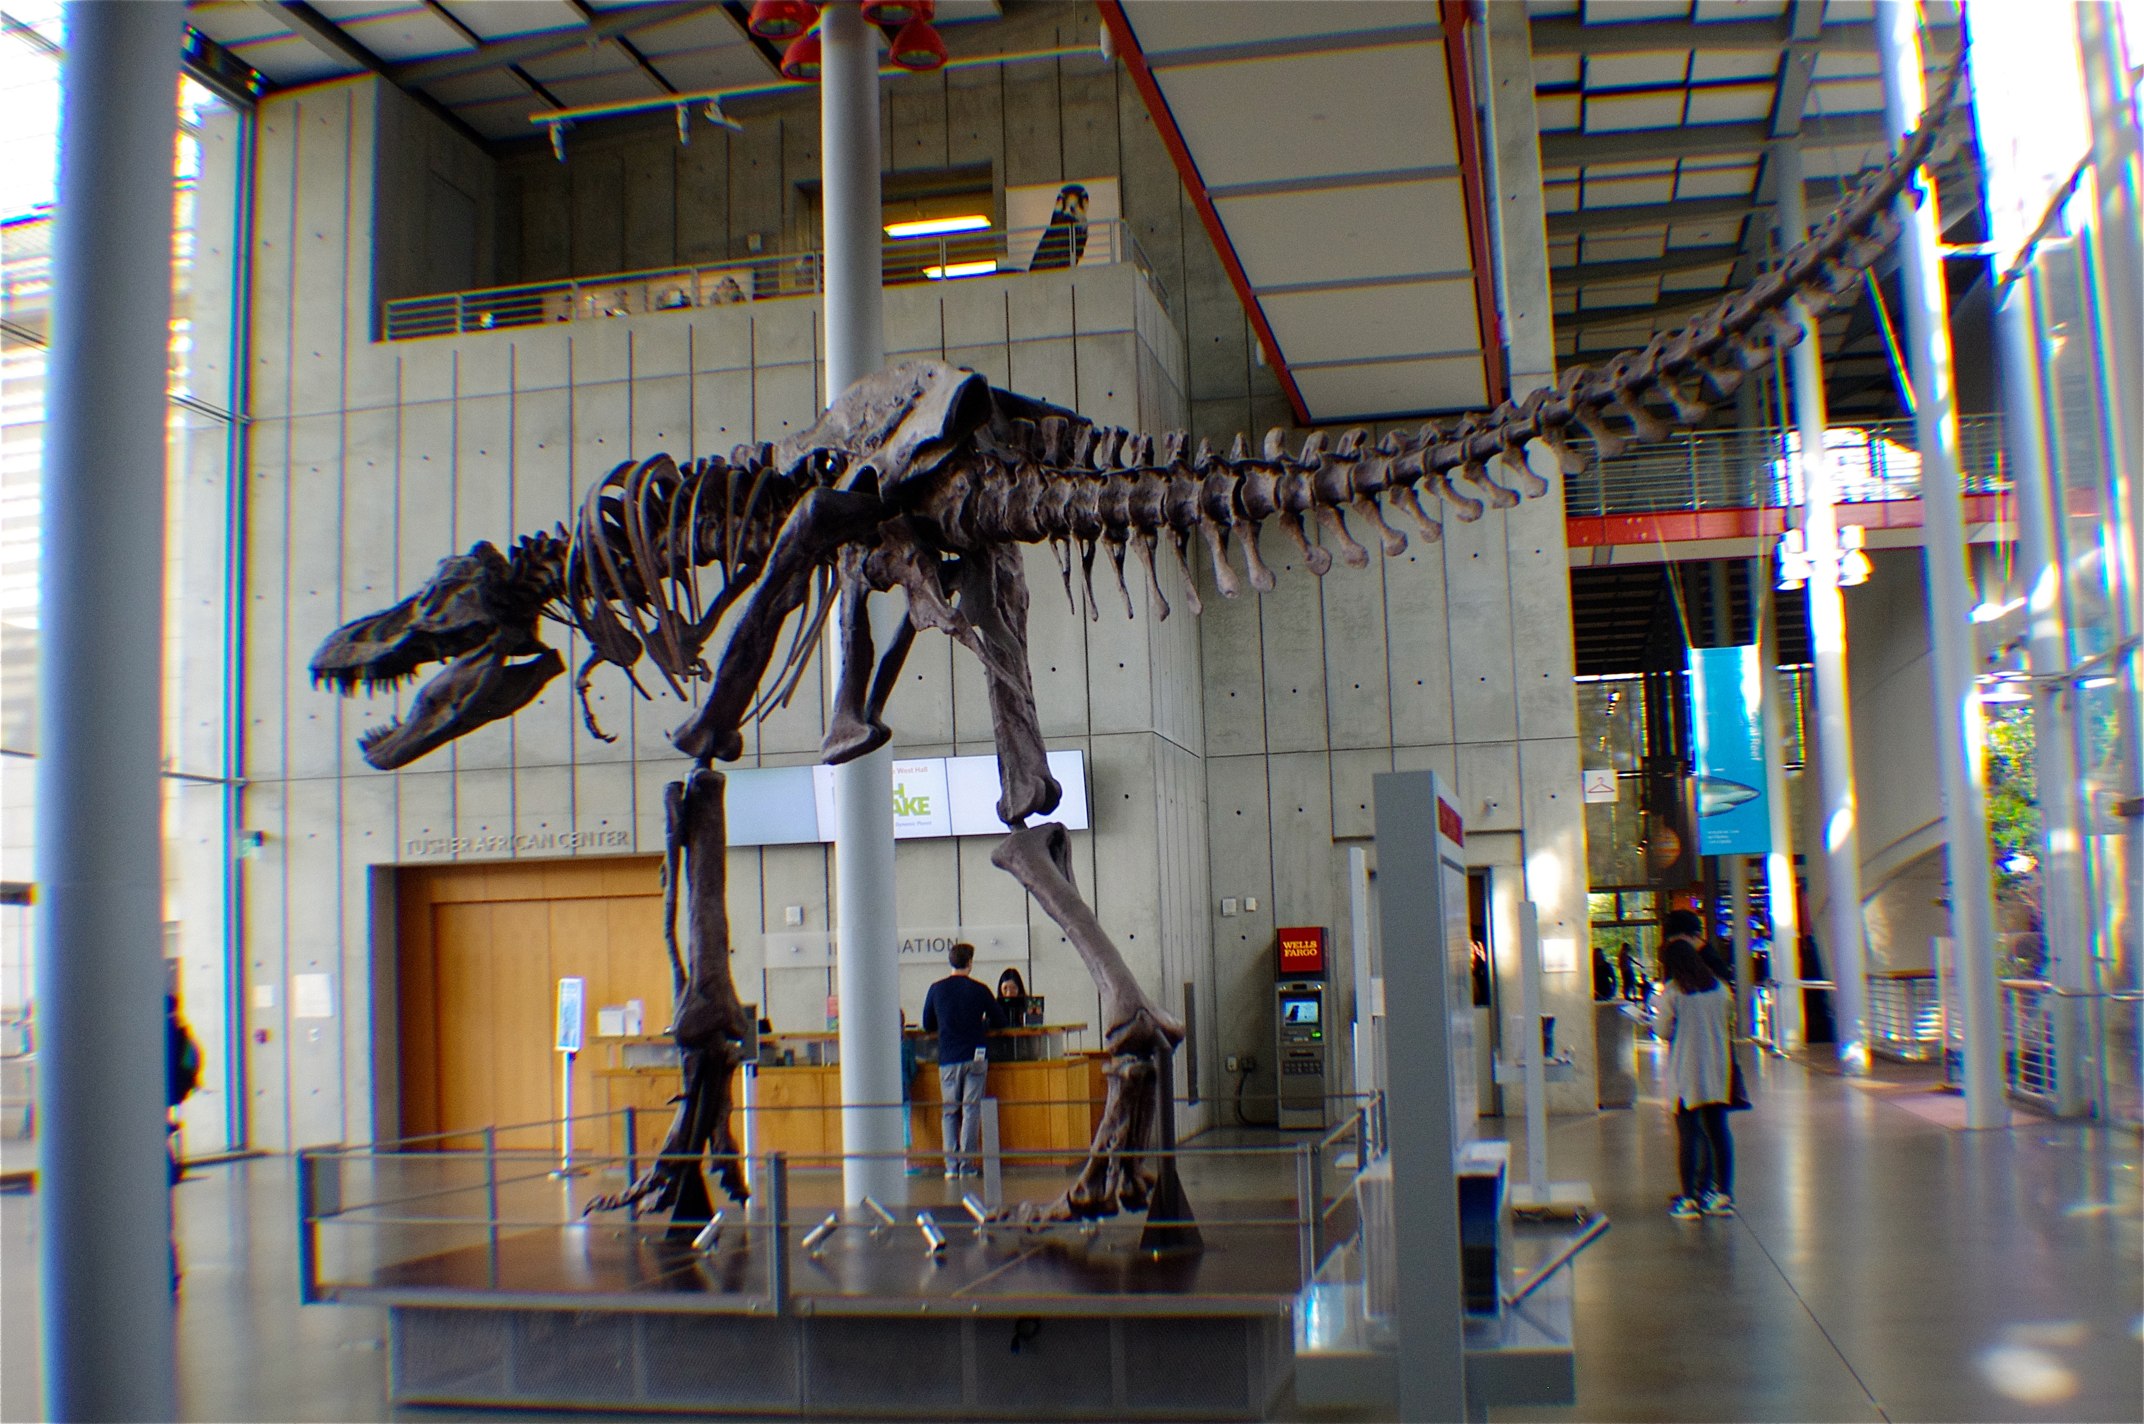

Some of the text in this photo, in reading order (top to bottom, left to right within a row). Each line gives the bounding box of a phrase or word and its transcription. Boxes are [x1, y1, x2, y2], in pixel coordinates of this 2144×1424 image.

[1750, 739, 1762, 761] Reef
[893, 796, 931, 816] AKE
[406, 831, 629, 856] TUSHER AFRICAN CENTER
[1283, 940, 1317, 949] WELLS
[1284, 948, 1318, 957] FARGO
